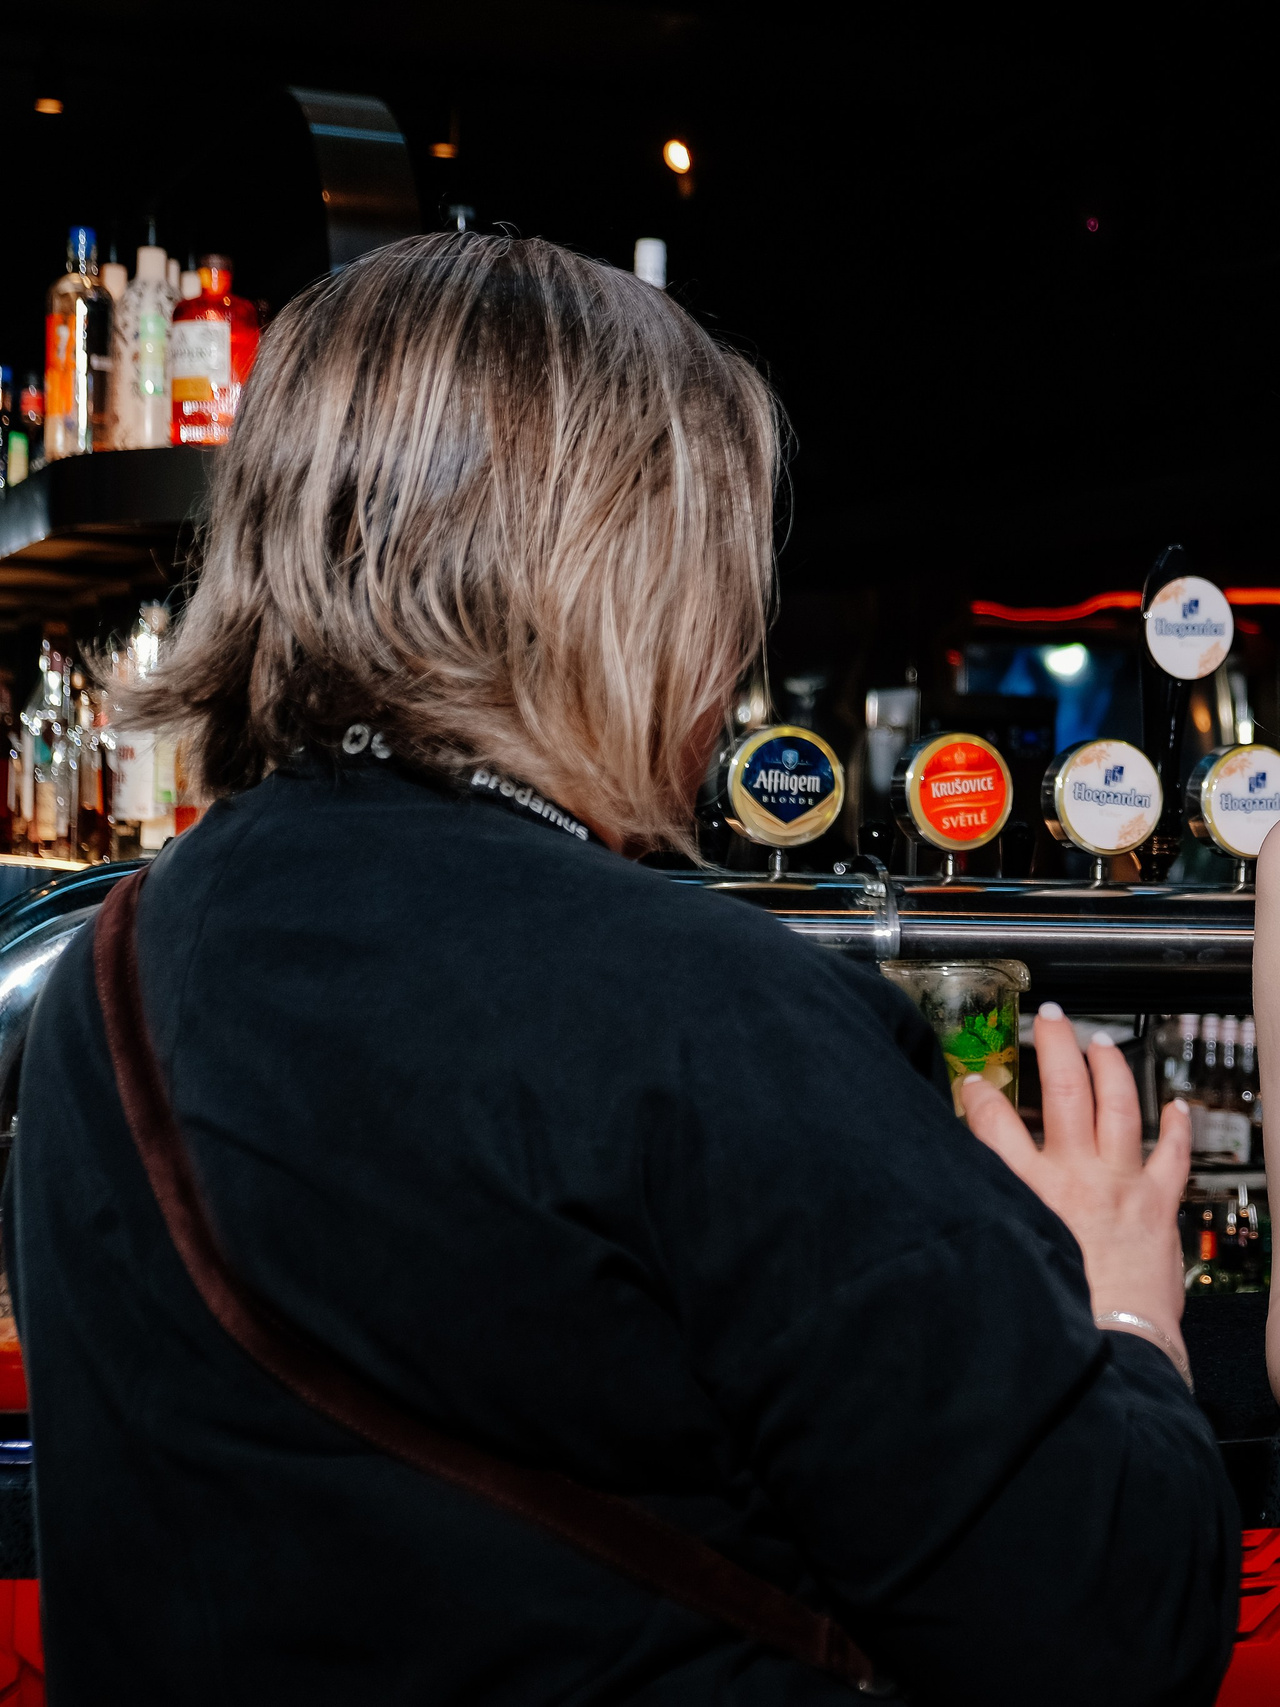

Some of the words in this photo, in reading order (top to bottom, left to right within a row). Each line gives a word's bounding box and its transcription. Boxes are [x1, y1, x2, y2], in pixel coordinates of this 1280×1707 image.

[753, 768, 820, 795] Affligem
[931, 776, 994, 799] KRUŠOVICE
[471, 768, 589, 841] prodamus
[762, 795, 814, 806] BLONDE
[1073, 782, 1152, 808] Hoegaarden
[941, 808, 988, 830] SVĚTLÉ
